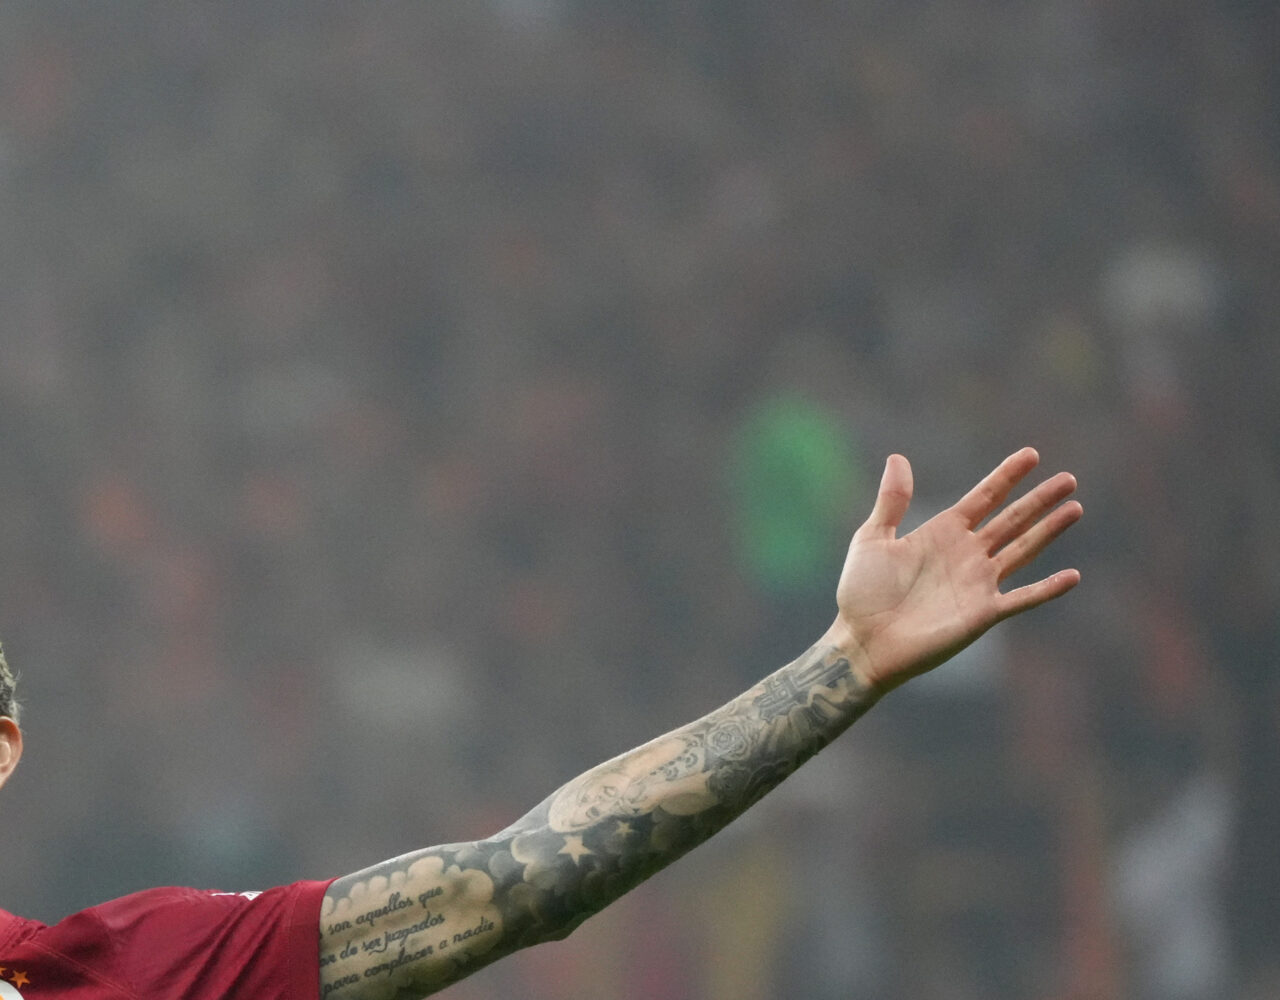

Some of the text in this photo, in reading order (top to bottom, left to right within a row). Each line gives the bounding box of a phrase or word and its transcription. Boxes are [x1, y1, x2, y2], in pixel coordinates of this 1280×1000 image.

[328, 886, 443, 935] son aquellos que
[340, 941, 358, 959] de
[362, 938, 382, 952] ser
[369, 911, 445, 956] juzgados
[323, 916, 495, 1000] para complacer a nadie
